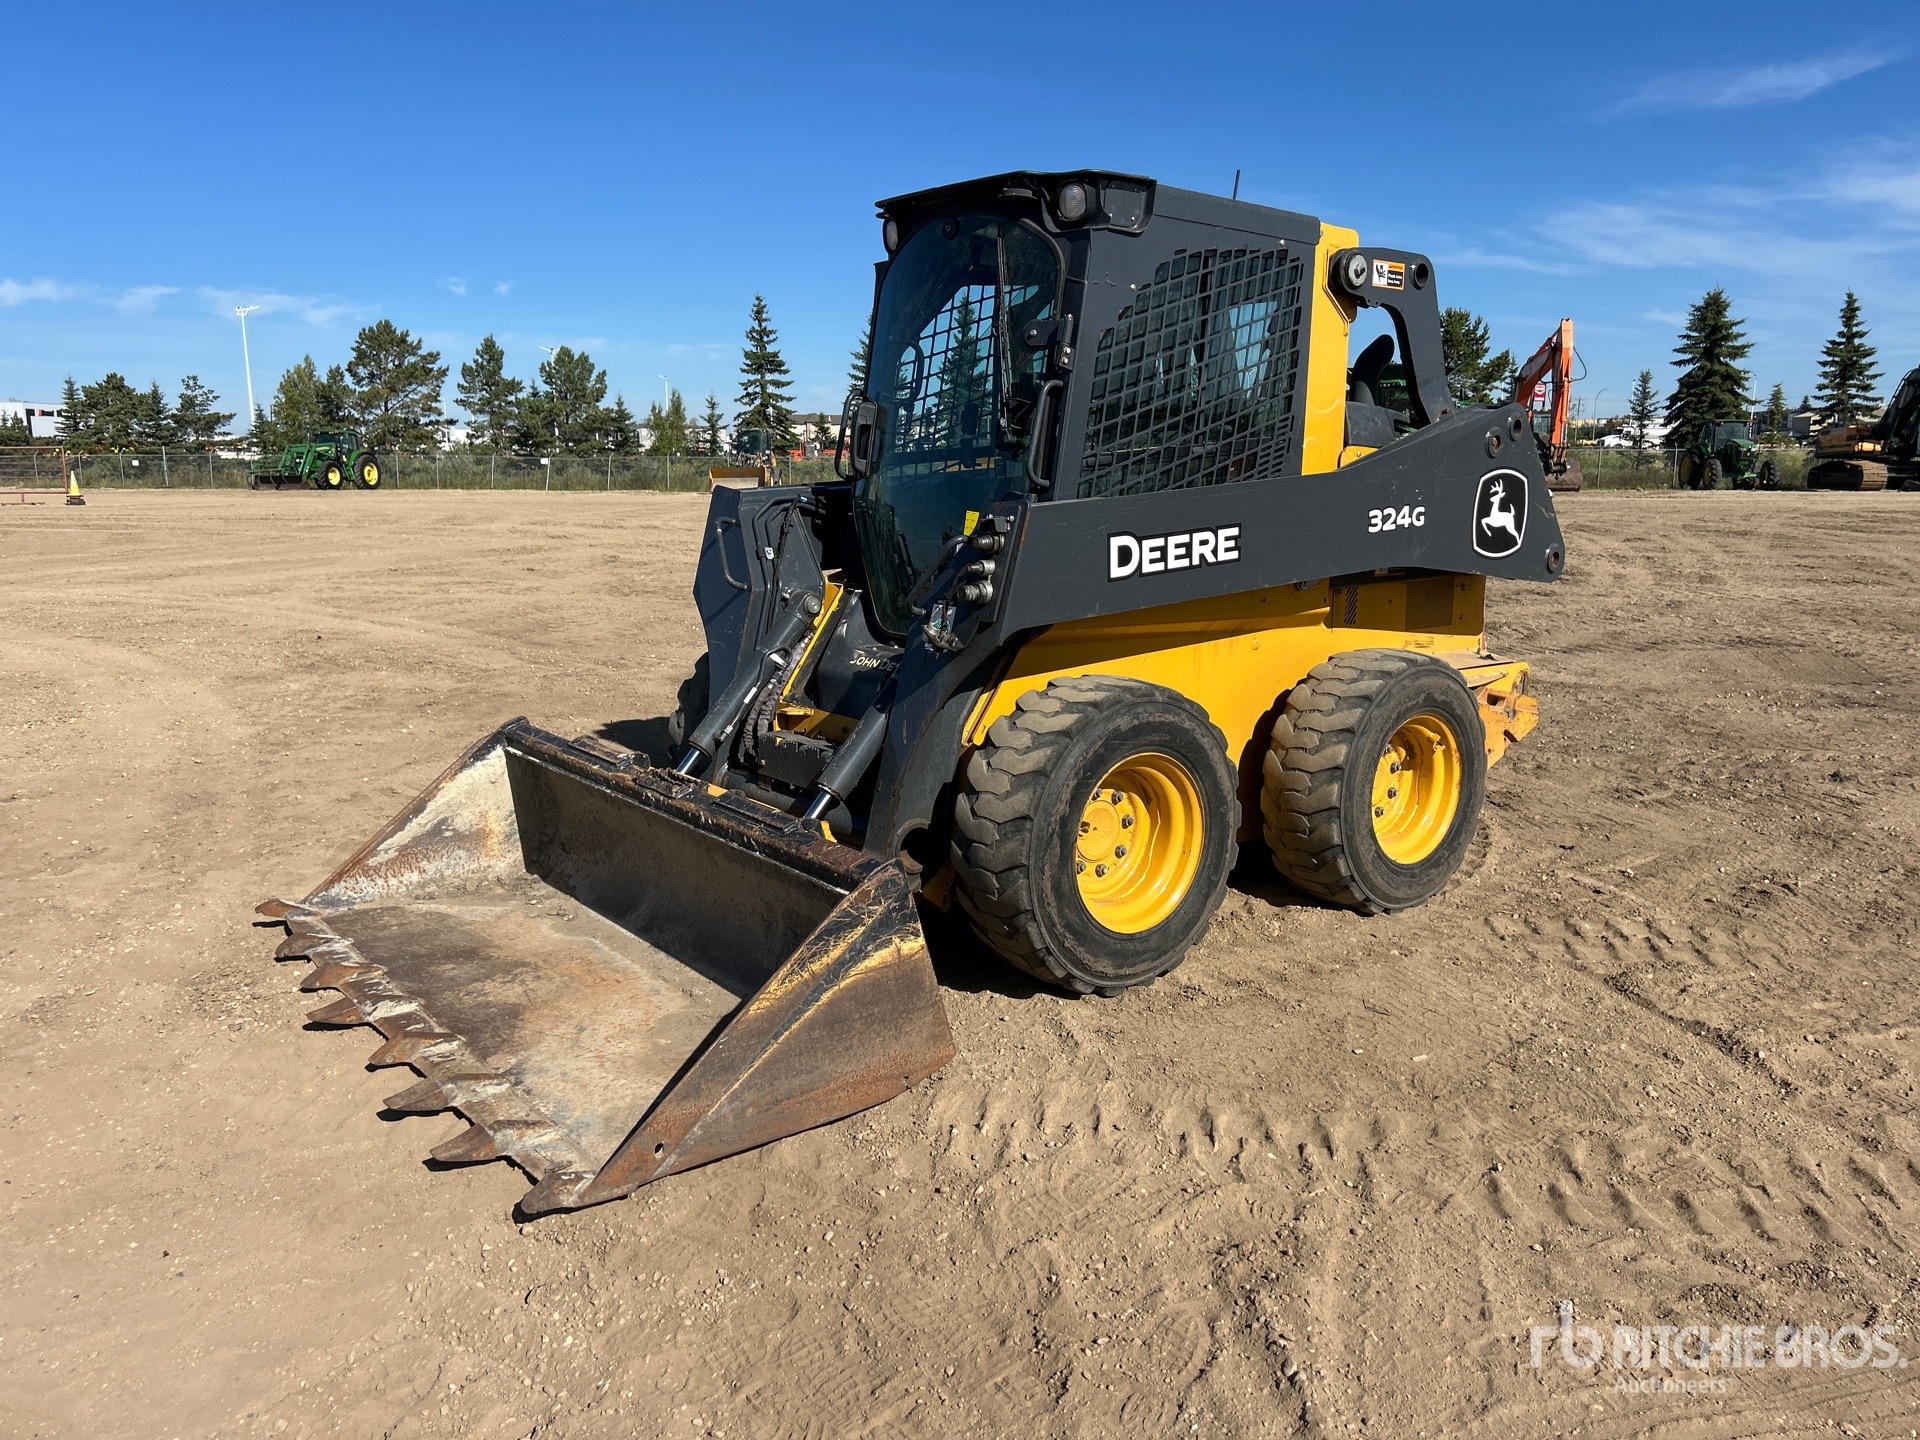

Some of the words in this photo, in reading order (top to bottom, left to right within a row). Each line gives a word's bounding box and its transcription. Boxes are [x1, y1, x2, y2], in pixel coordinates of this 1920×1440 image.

[1368, 505, 1425, 533] 324G
[1109, 526, 1240, 580] DEERE
[849, 656, 881, 668] JOHN
